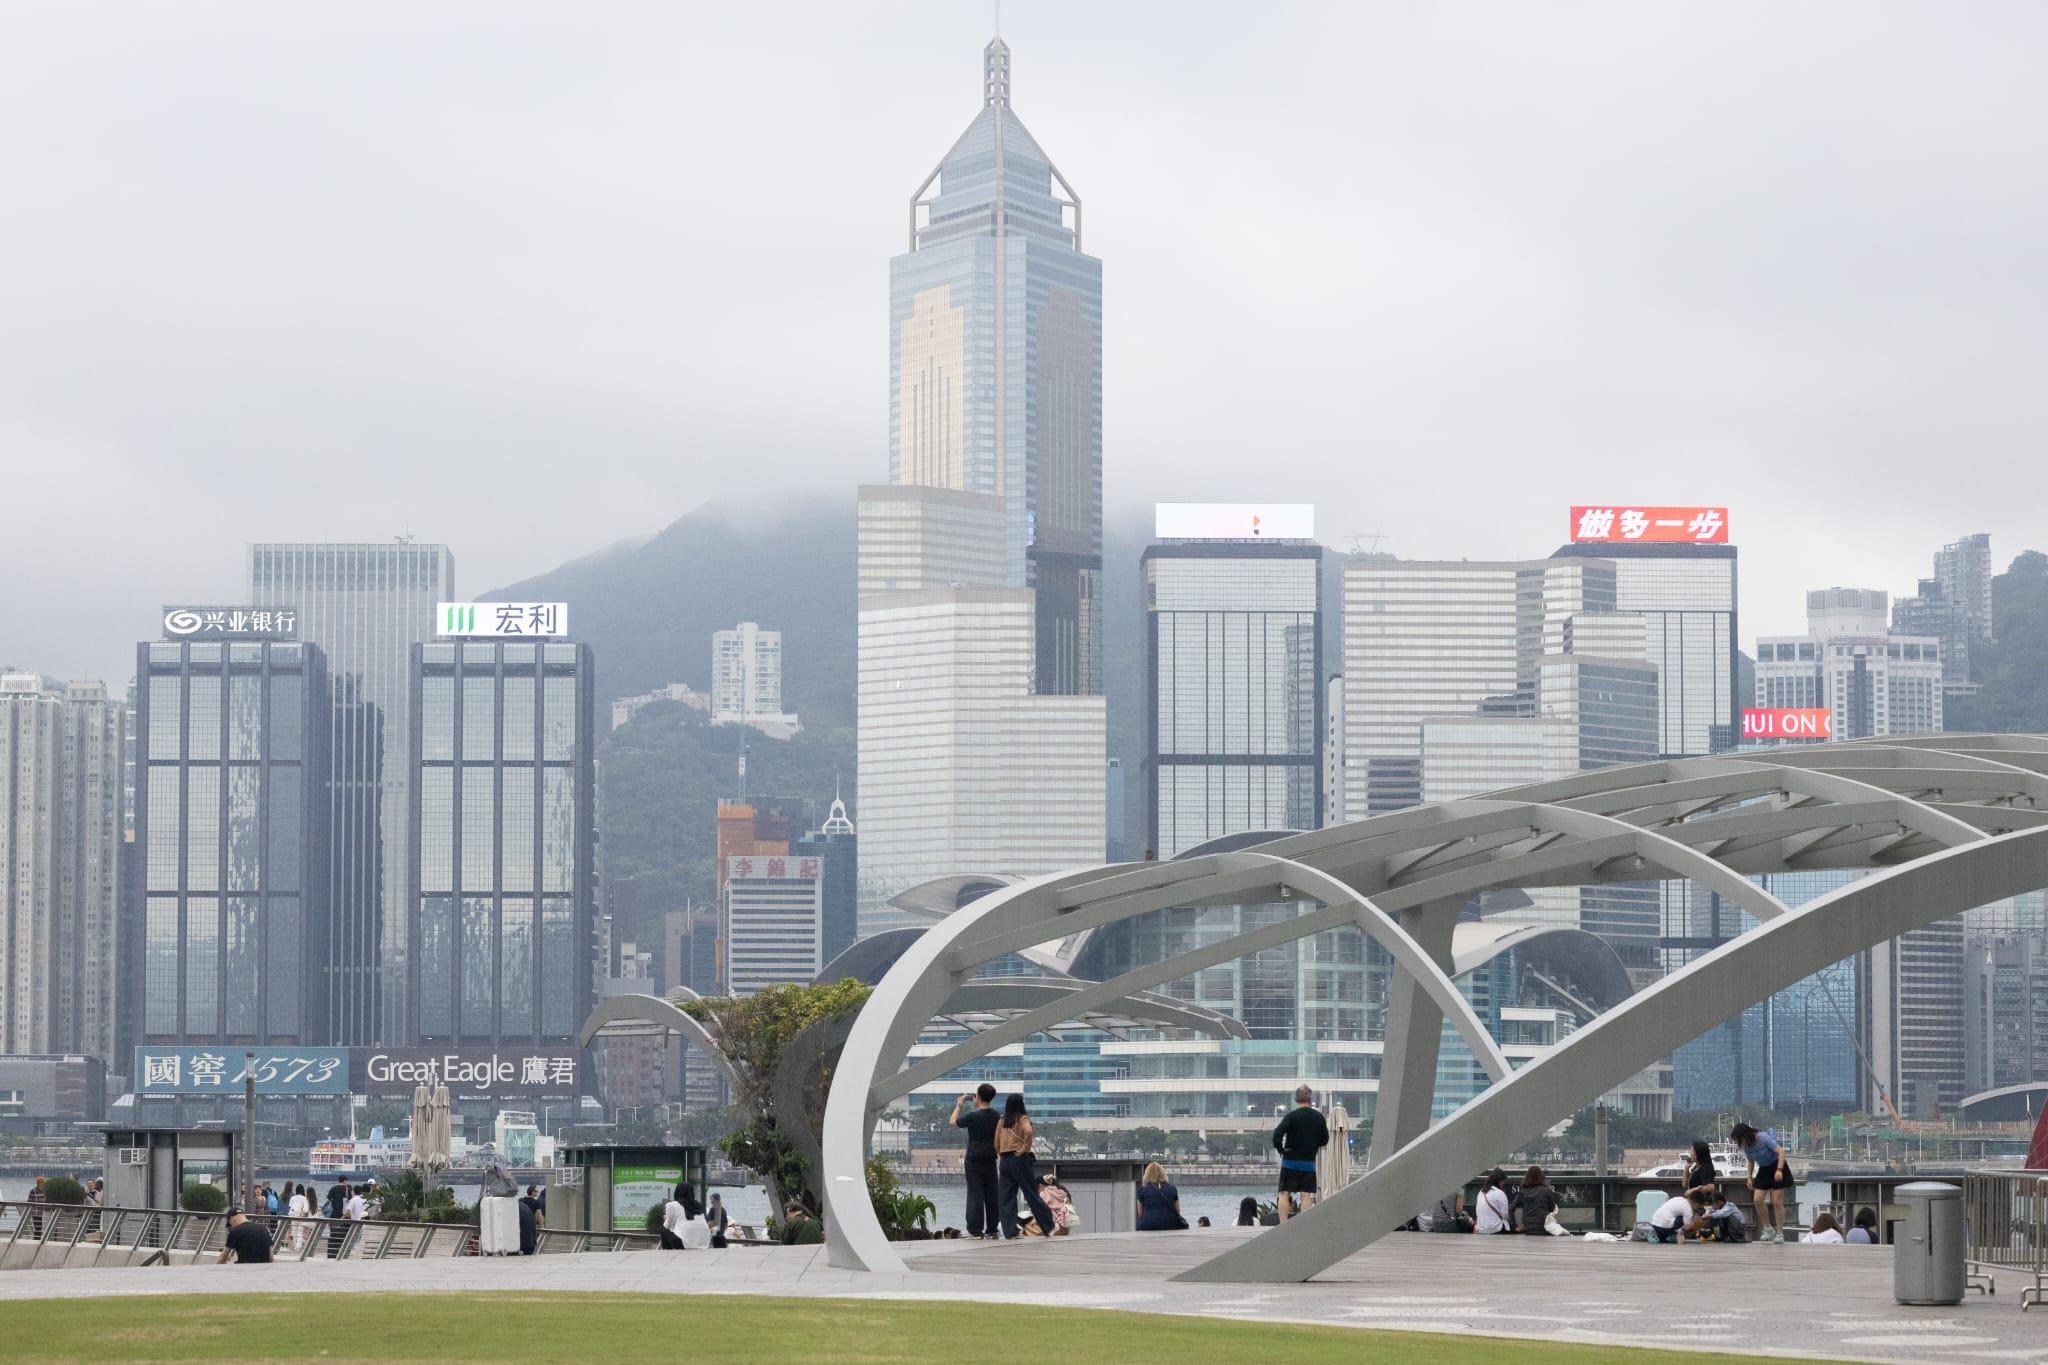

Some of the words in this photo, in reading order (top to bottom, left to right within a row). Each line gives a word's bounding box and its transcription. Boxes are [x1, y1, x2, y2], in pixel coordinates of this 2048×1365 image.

[1577, 509, 1723, 539] 做多一步
[203, 610, 296, 632] 兴业银行
[495, 604, 556, 634] 宏利
[1782, 714, 1816, 734] ON
[735, 857, 818, 880] 李錦記
[367, 1054, 440, 1082] Great
[444, 1054, 515, 1090] Eagle
[520, 1055, 577, 1085] 鷹君
